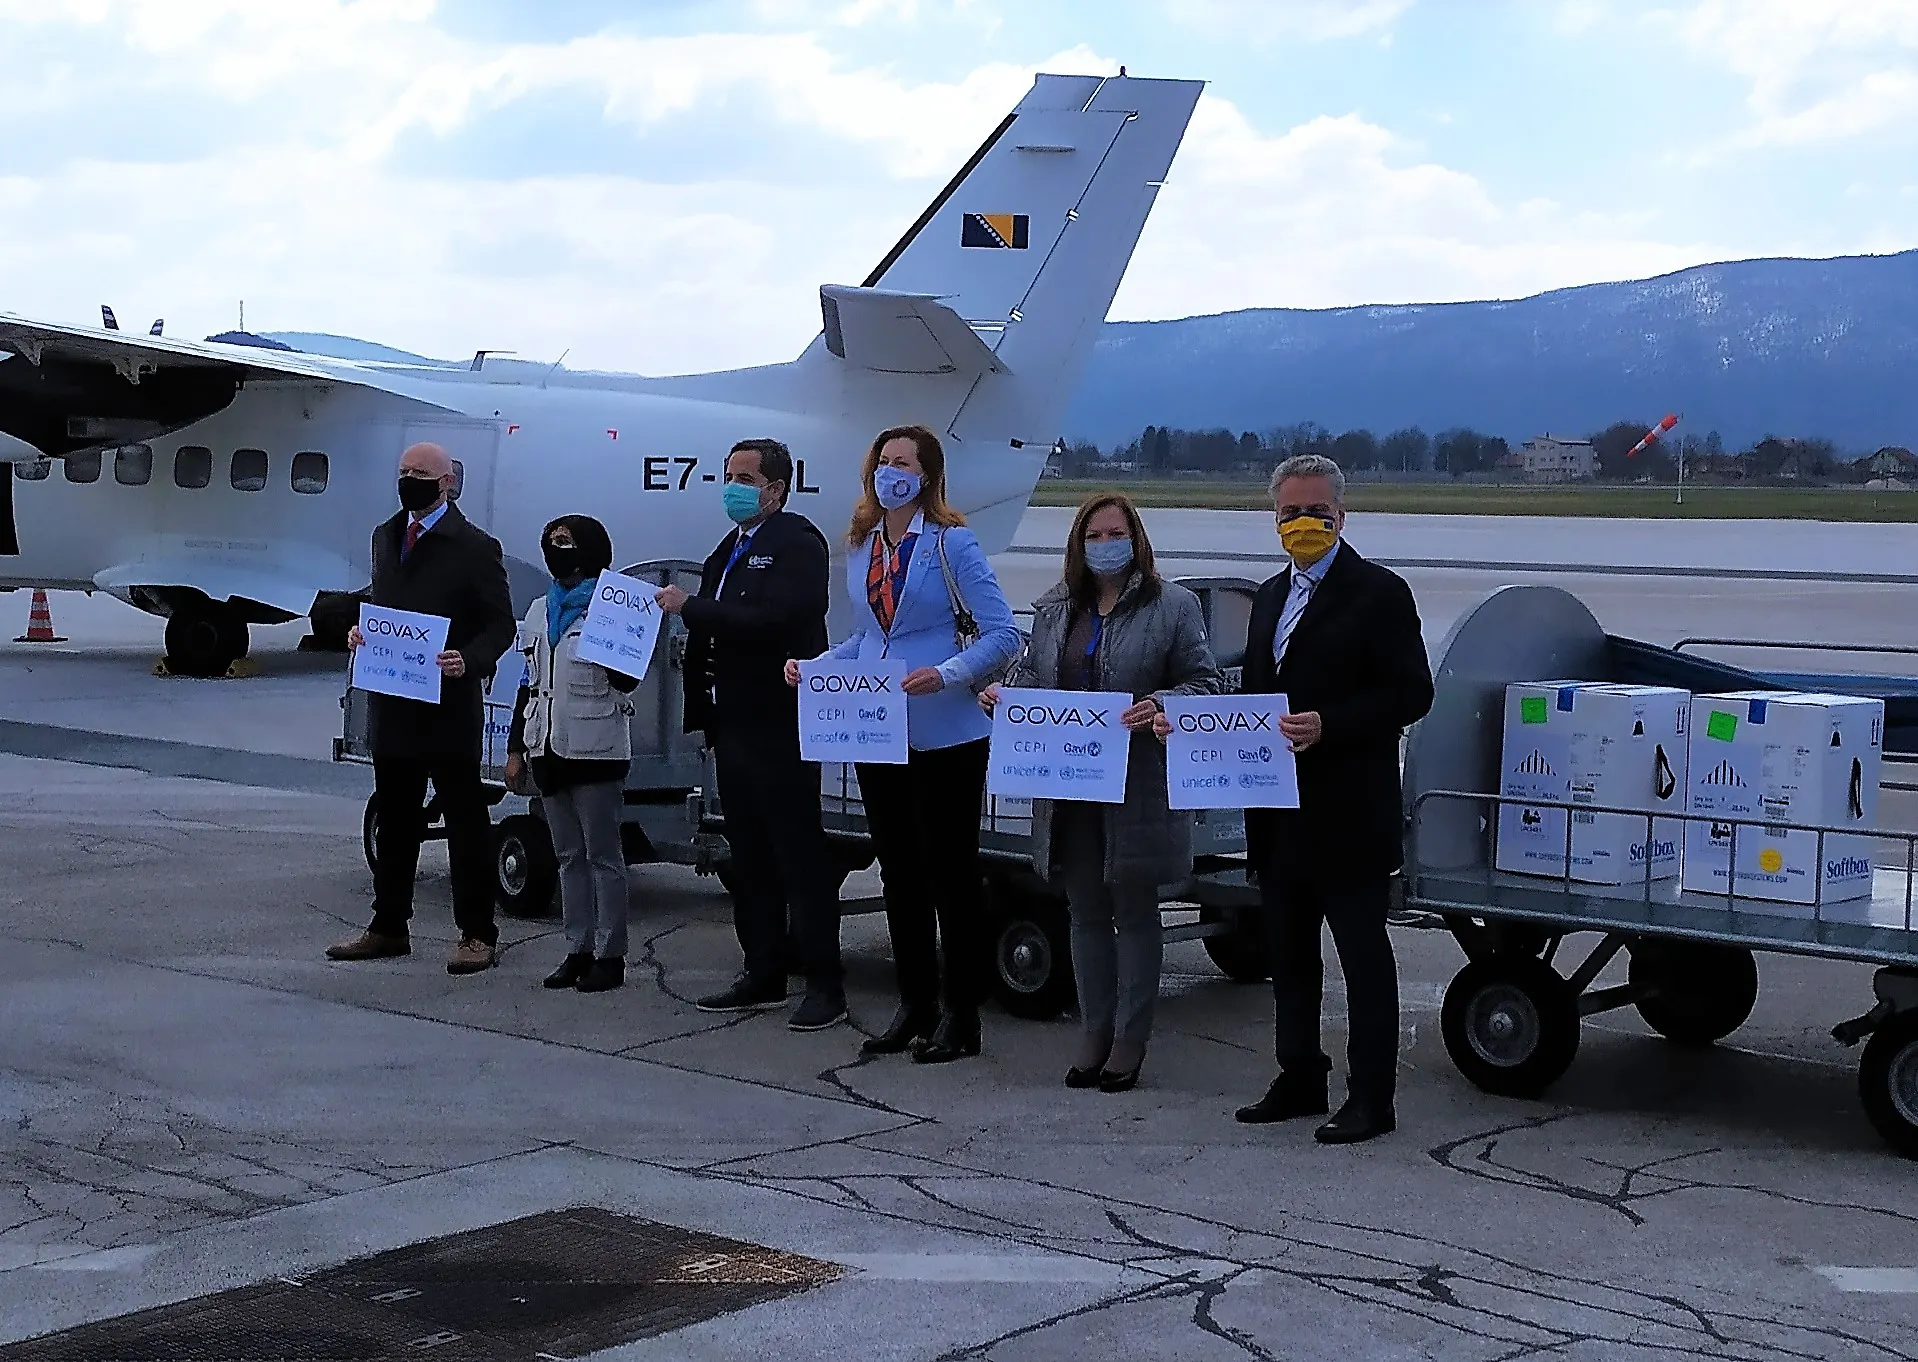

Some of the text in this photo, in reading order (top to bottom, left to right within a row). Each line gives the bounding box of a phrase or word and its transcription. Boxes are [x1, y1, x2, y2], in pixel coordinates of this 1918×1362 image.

[642, 456, 820, 494] E7-L
[601, 585, 655, 616] COVAX
[367, 618, 430, 643] COVAX
[372, 645, 393, 659] CEPI
[809, 675, 891, 693] COVAX
[817, 708, 845, 720] CEPI
[1007, 704, 1109, 728] COVAX
[1178, 711, 1272, 732] COVAX
[1014, 741, 1087, 754] CEPI Gavi
[1190, 749, 1258, 762] CEPI Gavi
[1182, 774, 1216, 788] unicef
[1629, 839, 1676, 861] Sobox
[1826, 856, 1870, 879] Softbox
